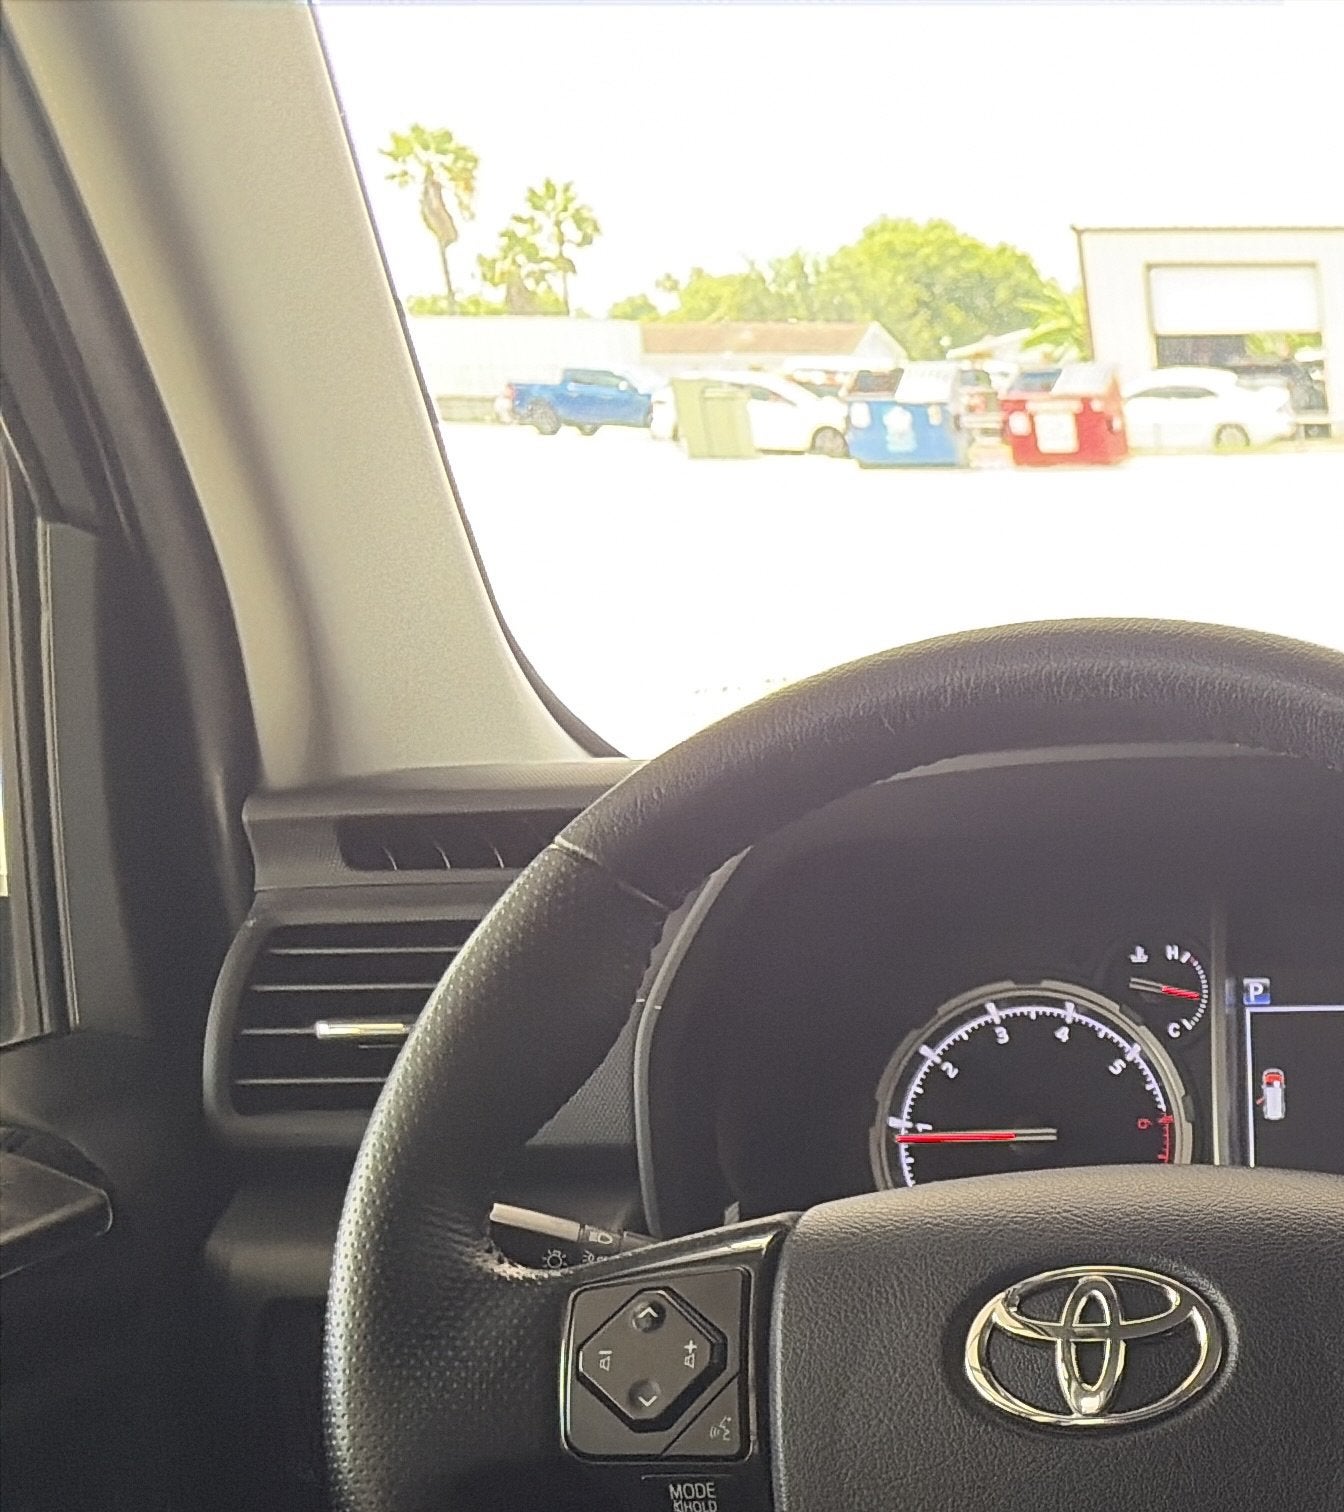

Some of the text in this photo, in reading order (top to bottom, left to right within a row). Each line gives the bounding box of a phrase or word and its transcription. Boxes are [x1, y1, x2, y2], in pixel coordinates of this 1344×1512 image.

[1165, 944, 1179, 961] H
[1249, 982, 1264, 1002] P
[994, 1026, 1010, 1044] 3
[1054, 1026, 1070, 1043] 4
[1167, 1022, 1181, 1038] C
[941, 1061, 959, 1078] 2
[1108, 1058, 1127, 1075] 5
[915, 1122, 933, 1132] 1
[669, 1482, 717, 1500] MODE
